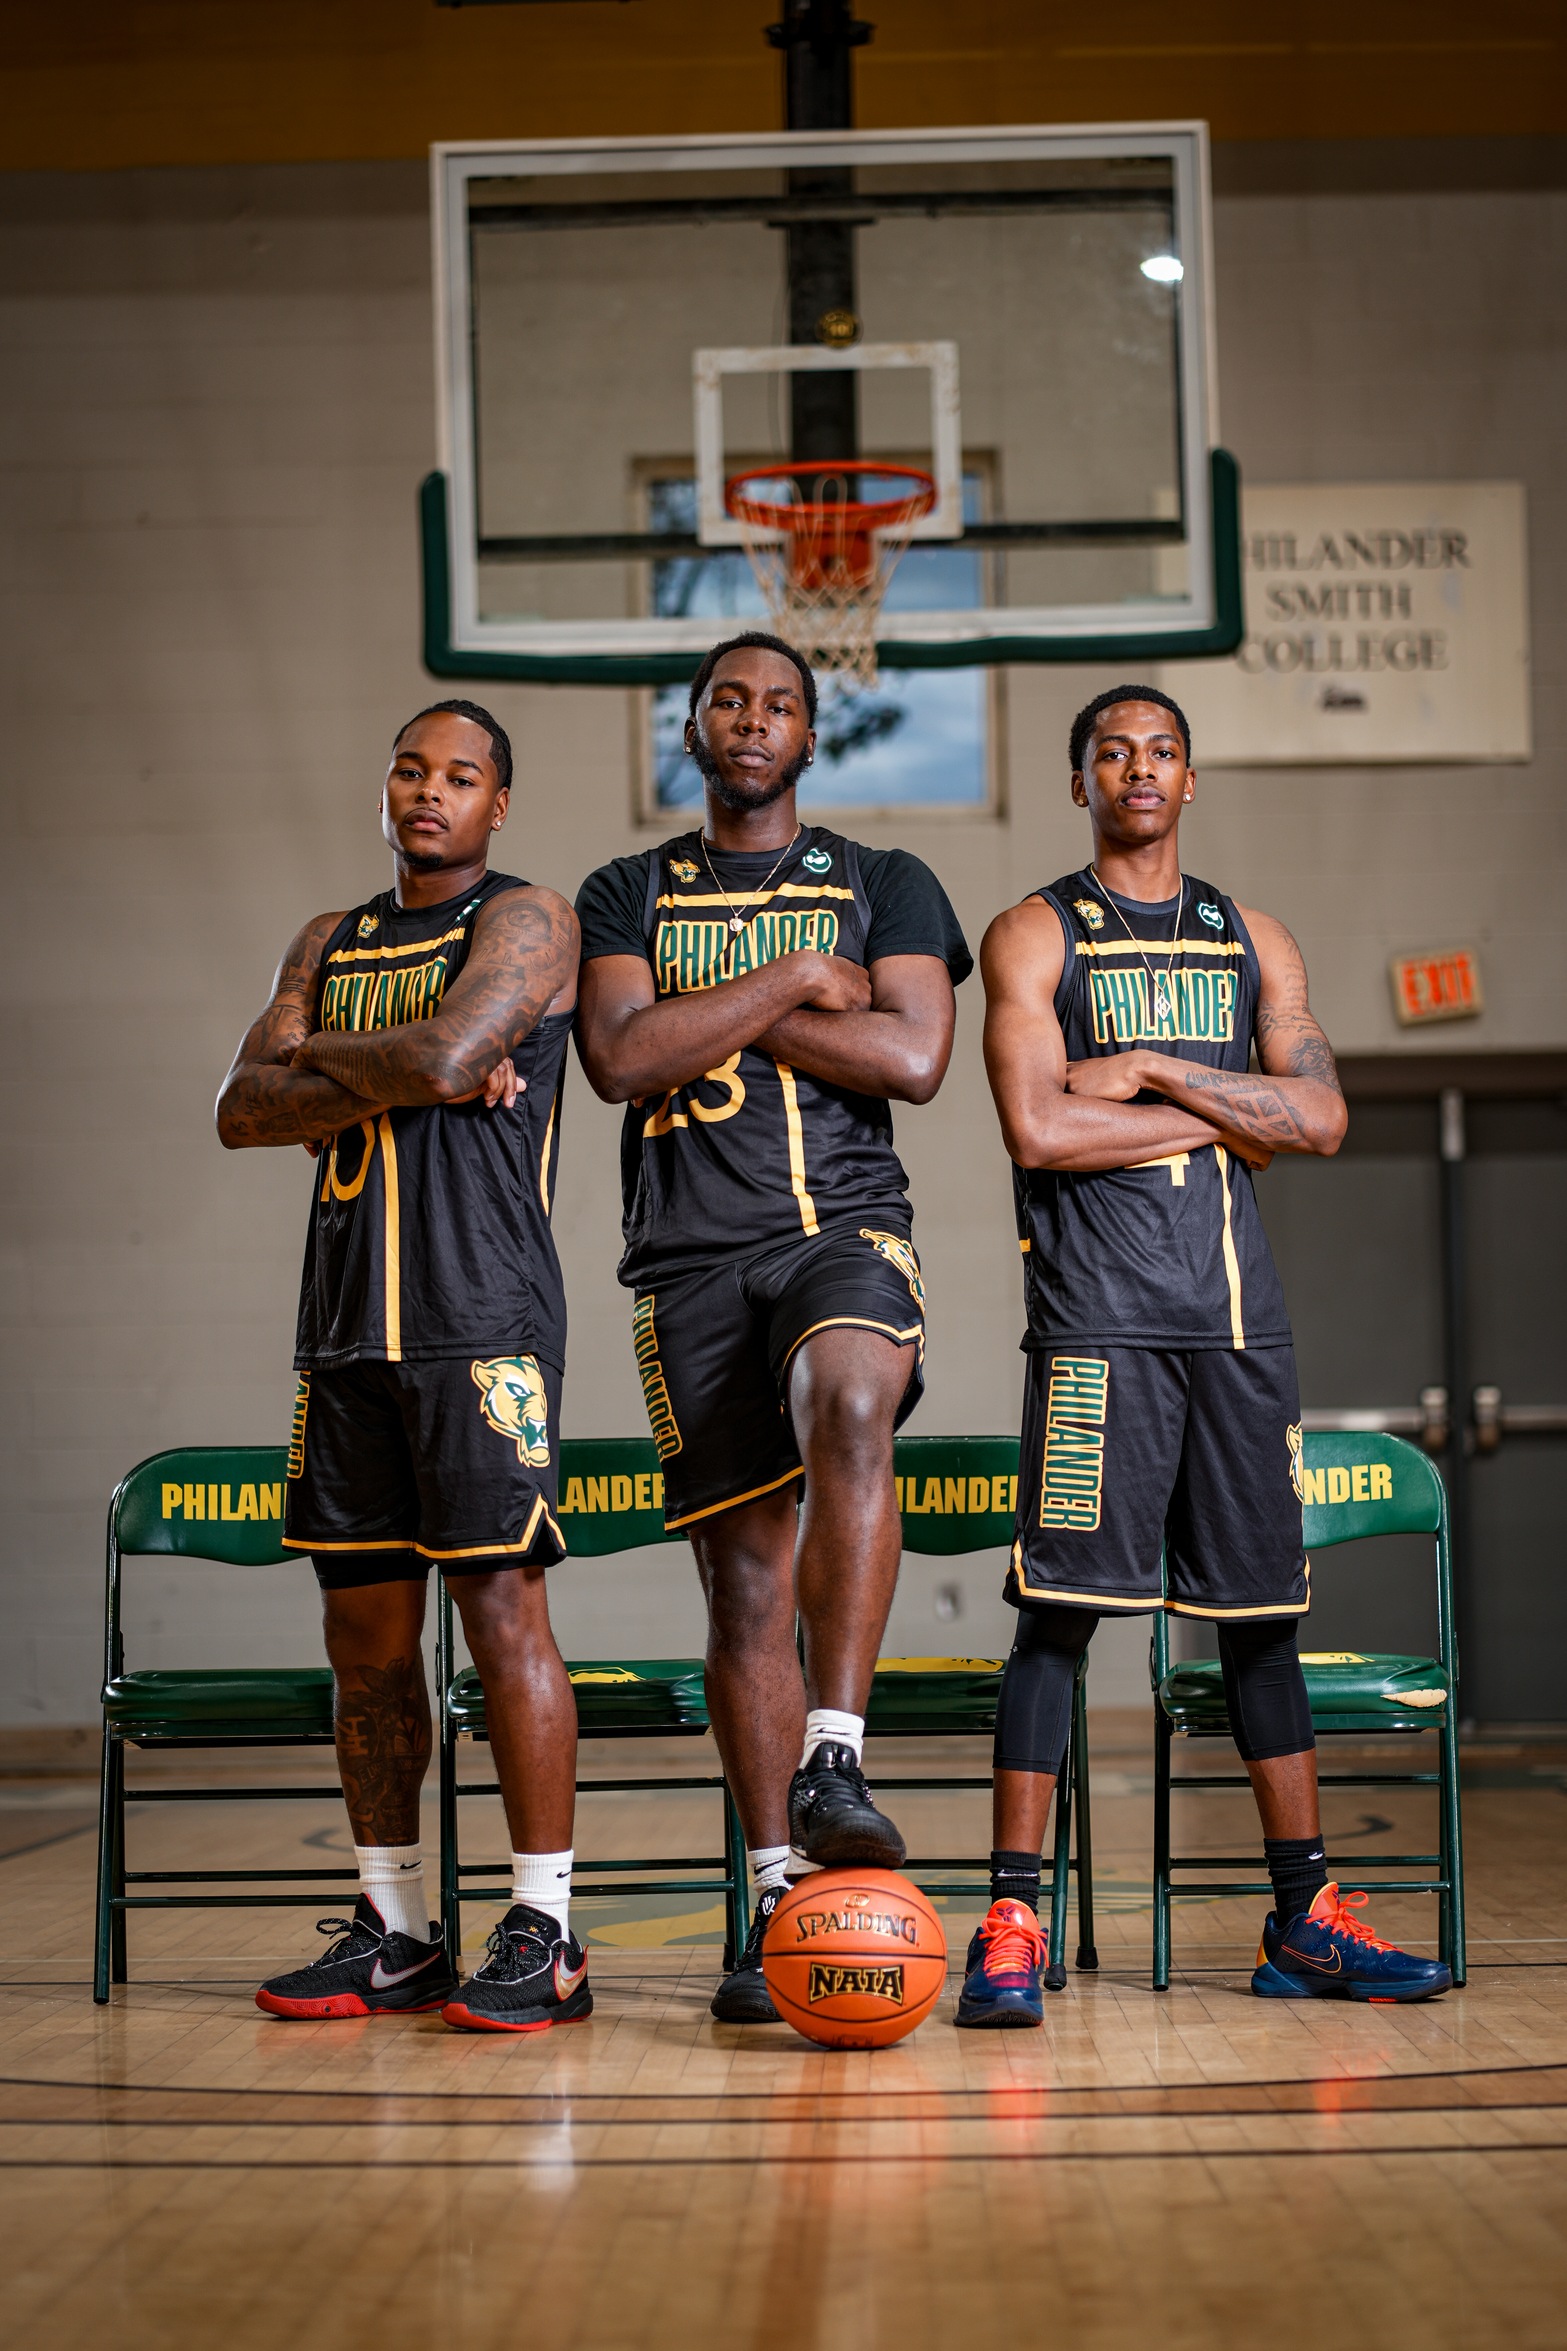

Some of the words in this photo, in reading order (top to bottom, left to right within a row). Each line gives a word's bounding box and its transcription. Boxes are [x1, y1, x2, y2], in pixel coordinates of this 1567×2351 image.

[1265, 578, 1413, 622] SMITH
[1237, 627, 1450, 674] COLLEGE
[655, 908, 839, 994] PHILANDER
[1039, 1356, 1110, 1532] PHILANDER
[161, 1483, 288, 1521] PHILAN
[796, 1911, 917, 1945] SPALDING
[809, 1961, 905, 2006] NAIA
